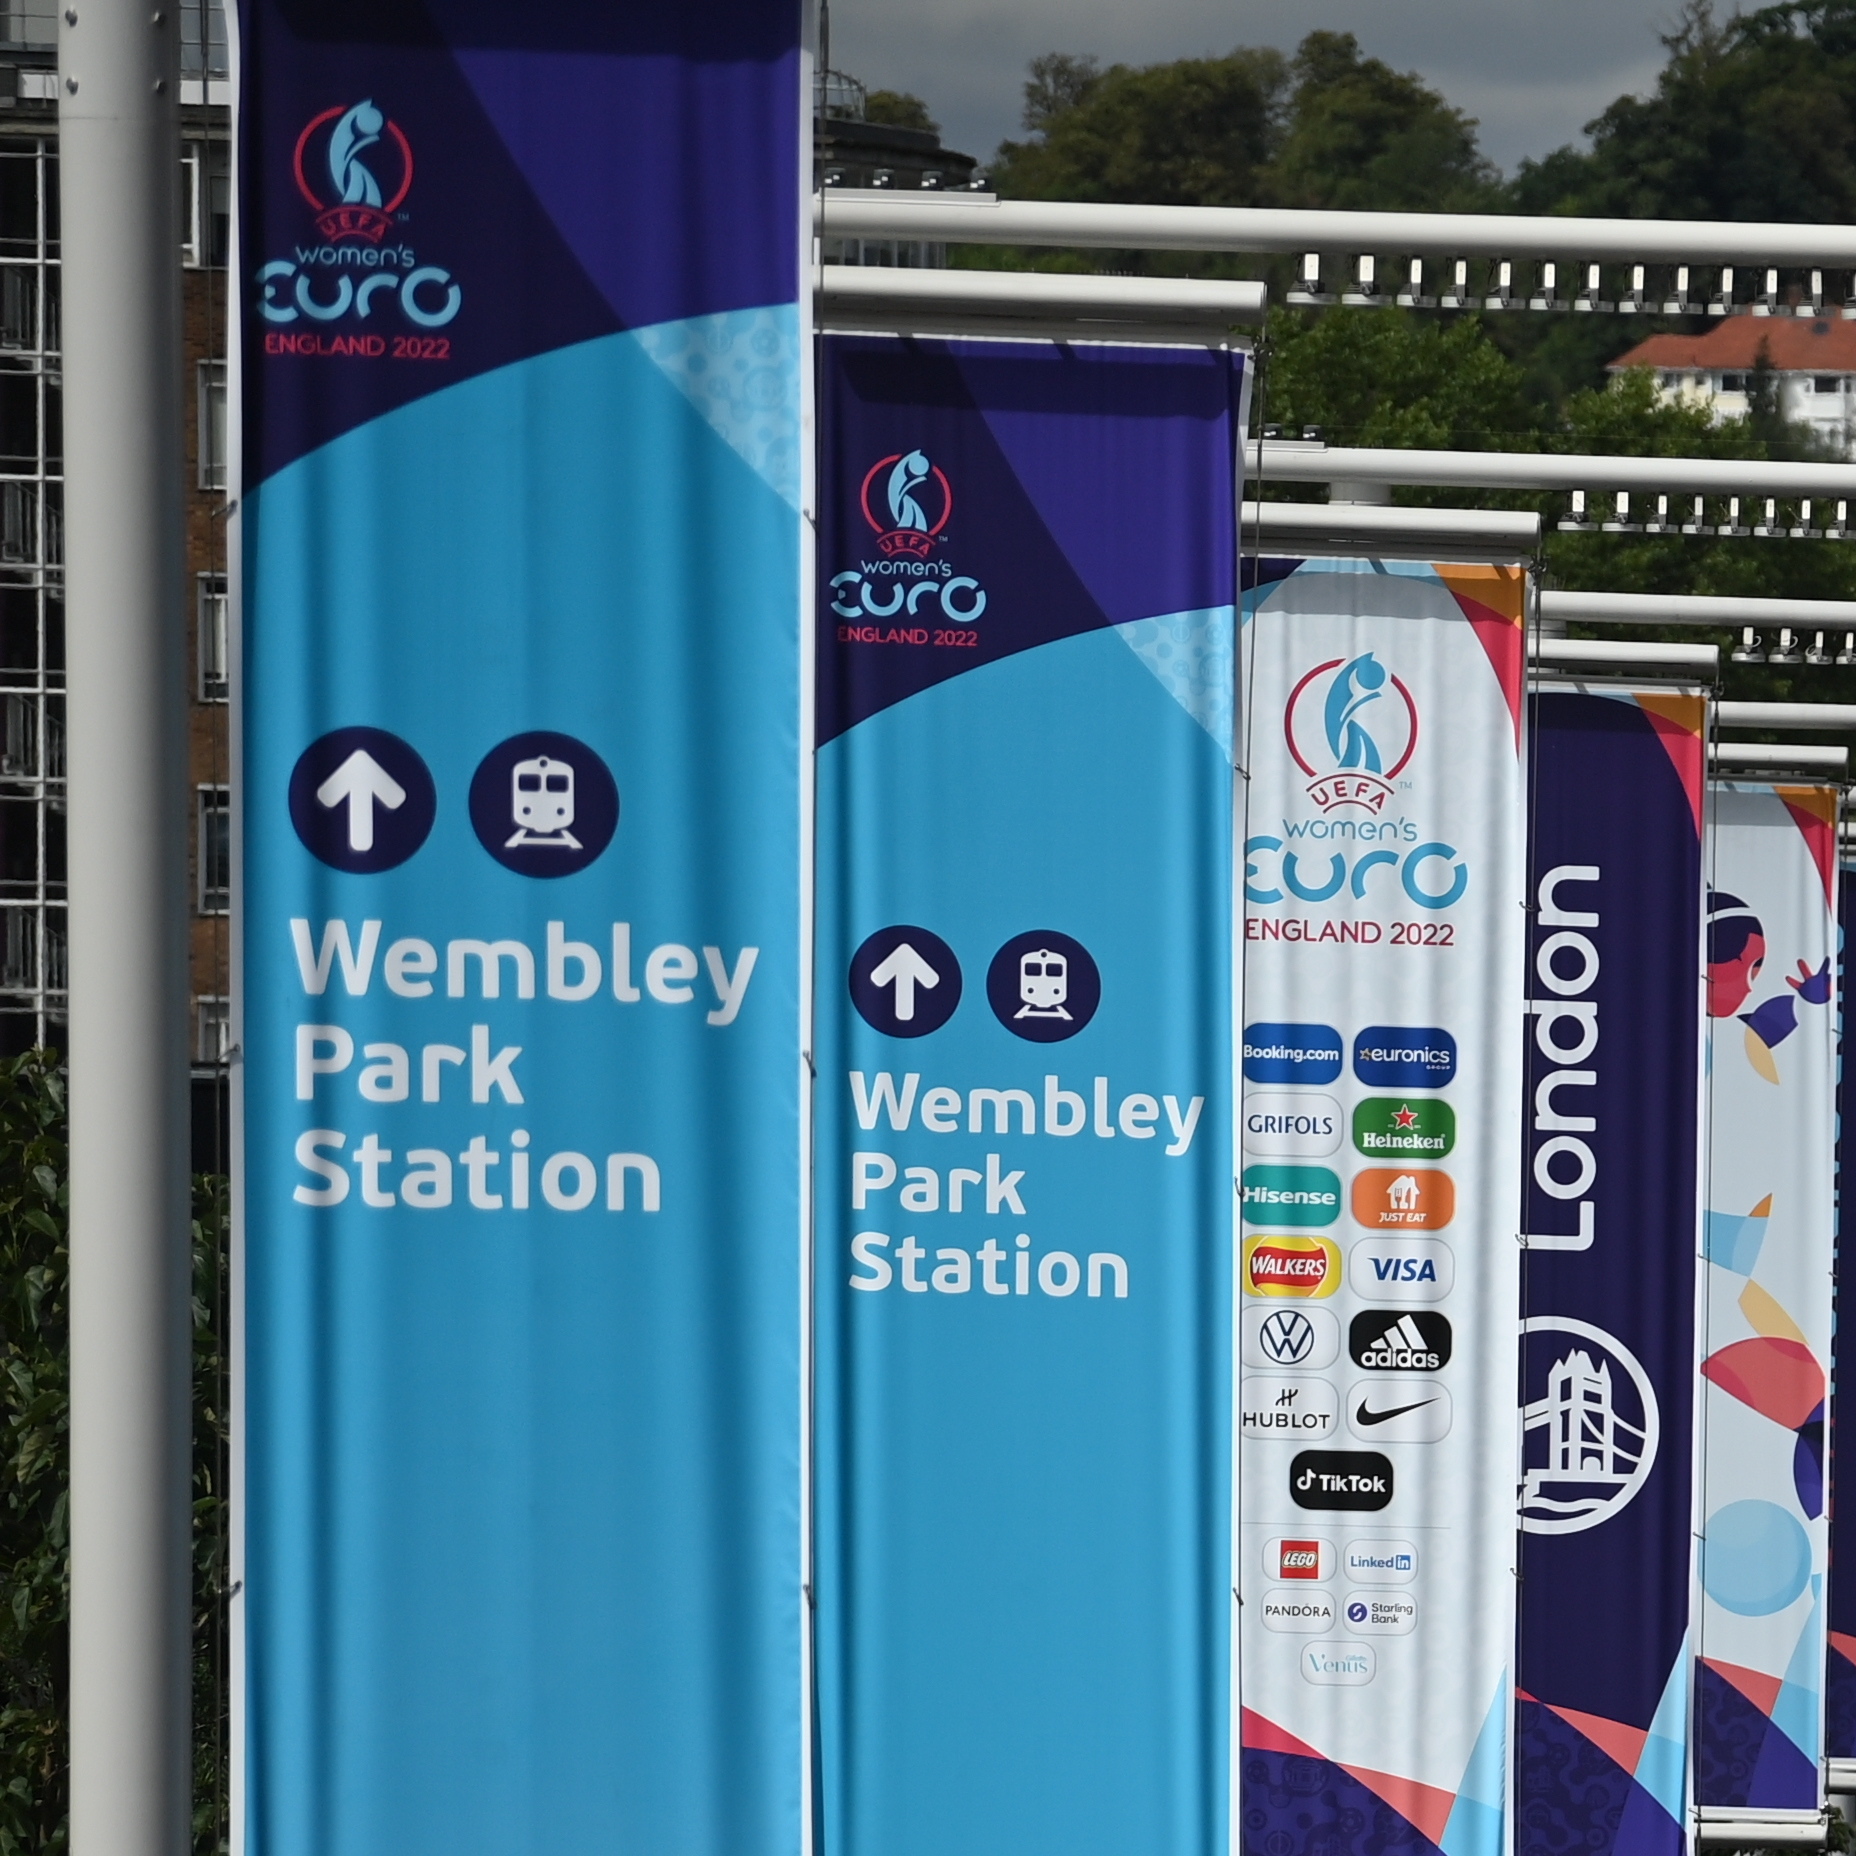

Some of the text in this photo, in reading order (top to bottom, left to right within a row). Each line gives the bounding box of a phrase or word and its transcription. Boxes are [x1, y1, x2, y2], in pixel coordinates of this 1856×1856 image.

[320, 211, 388, 238] UEFA
[295, 244, 415, 268] women's
[264, 333, 450, 359] ENGLAND 2022
[880, 535, 931, 555] UEFA
[861, 559, 952, 577] women's
[838, 626, 978, 646] ENGLAND 2022
[1311, 780, 1386, 810] UEFA
[1282, 816, 1418, 842] women's
[1245, 918, 1455, 947] ENGLAND 2022
[290, 917, 760, 1026] Wembley
[296, 1023, 525, 1104] Park
[1244, 1045, 1339, 1062] Booking.com
[1371, 1047, 1450, 1064] euronics
[1520, 863, 1600, 1252] London
[849, 1070, 1205, 1157] Wembley
[1247, 1114, 1333, 1135] GRIFOLS
[1363, 1132, 1446, 1150] Heineken
[293, 1128, 661, 1212] Station
[852, 1151, 1027, 1215] Park
[1244, 1187, 1336, 1206] Hisense
[1379, 1212, 1427, 1223] JUST EAT
[848, 1231, 1128, 1299] Station
[1251, 1253, 1325, 1276] WALKERS
[1367, 1257, 1437, 1282] VISA
[1361, 1349, 1439, 1369] adidas
[1243, 1413, 1330, 1430] HUBLOT
[1319, 1474, 1386, 1494] TikTok
[1282, 1550, 1317, 1568] LEGO
[1371, 1603, 1413, 1616] Starling
[1371, 1614, 1400, 1624] Bank
[1309, 1653, 1368, 1673] Venus
